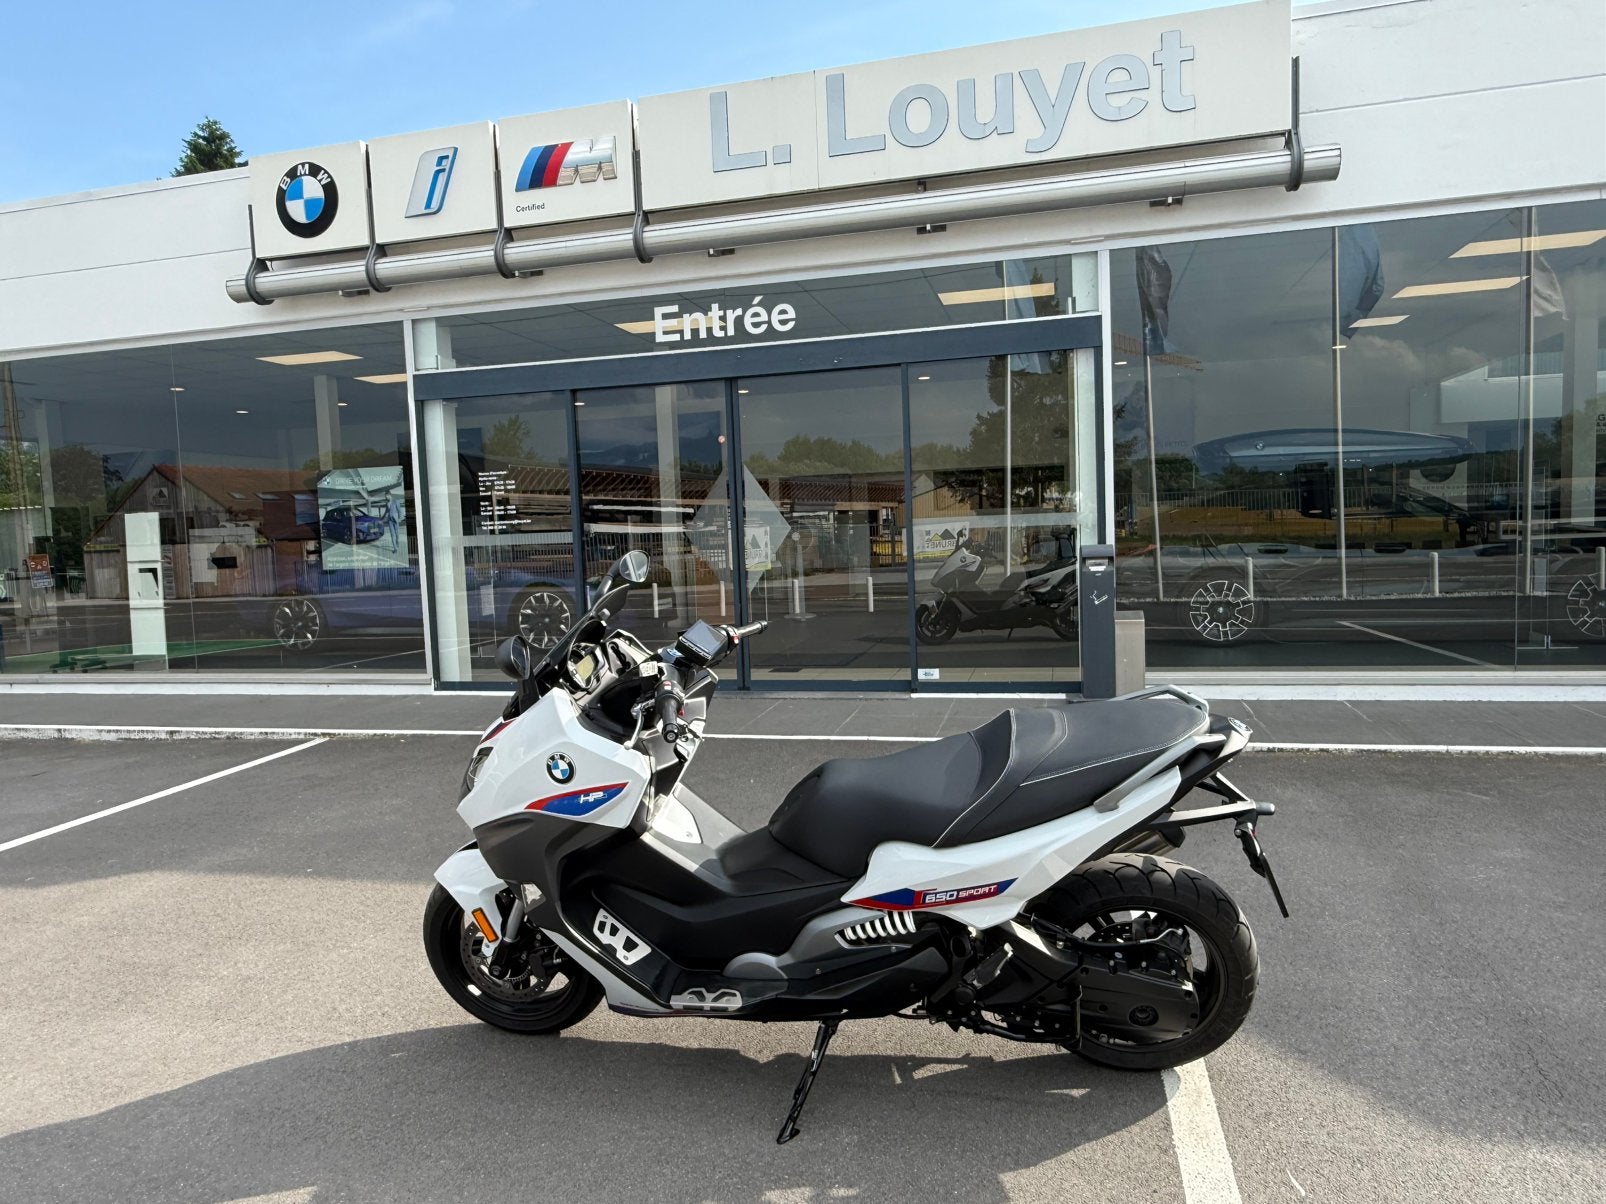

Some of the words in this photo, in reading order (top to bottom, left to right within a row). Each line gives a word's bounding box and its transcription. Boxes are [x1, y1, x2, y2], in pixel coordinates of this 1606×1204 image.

[709, 91, 792, 173] L.
[826, 30, 1197, 157] Louyet
[280, 163, 331, 190] BMW
[515, 203, 546, 213] Certified
[653, 295, 797, 342] Entrée
[547, 753, 571, 765] BMW
[579, 791, 604, 804] HP
[925, 890, 958, 904] 650
[958, 884, 998, 898] SPORT
